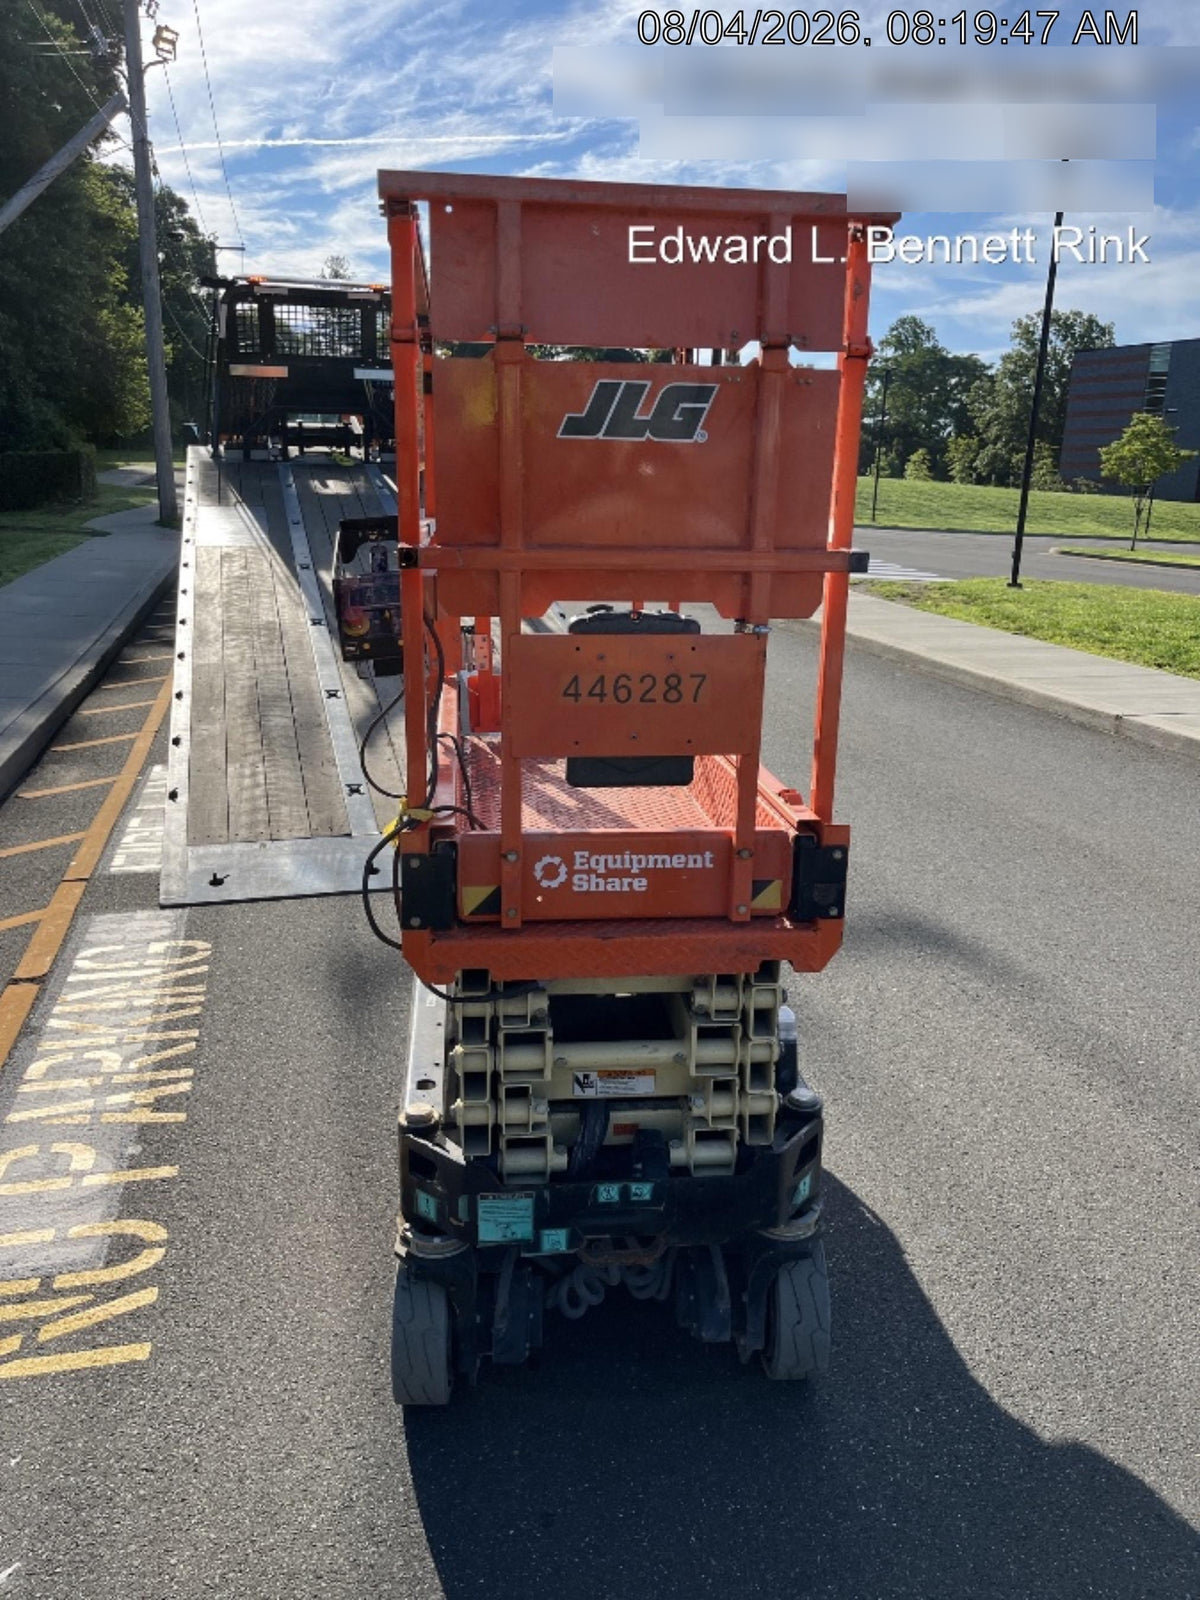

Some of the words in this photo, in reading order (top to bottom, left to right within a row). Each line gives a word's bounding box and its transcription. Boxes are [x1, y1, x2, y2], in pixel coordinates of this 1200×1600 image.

[562, 673, 708, 704] 446287
[573, 851, 714, 873] Equipment
[572, 874, 648, 892] Share
